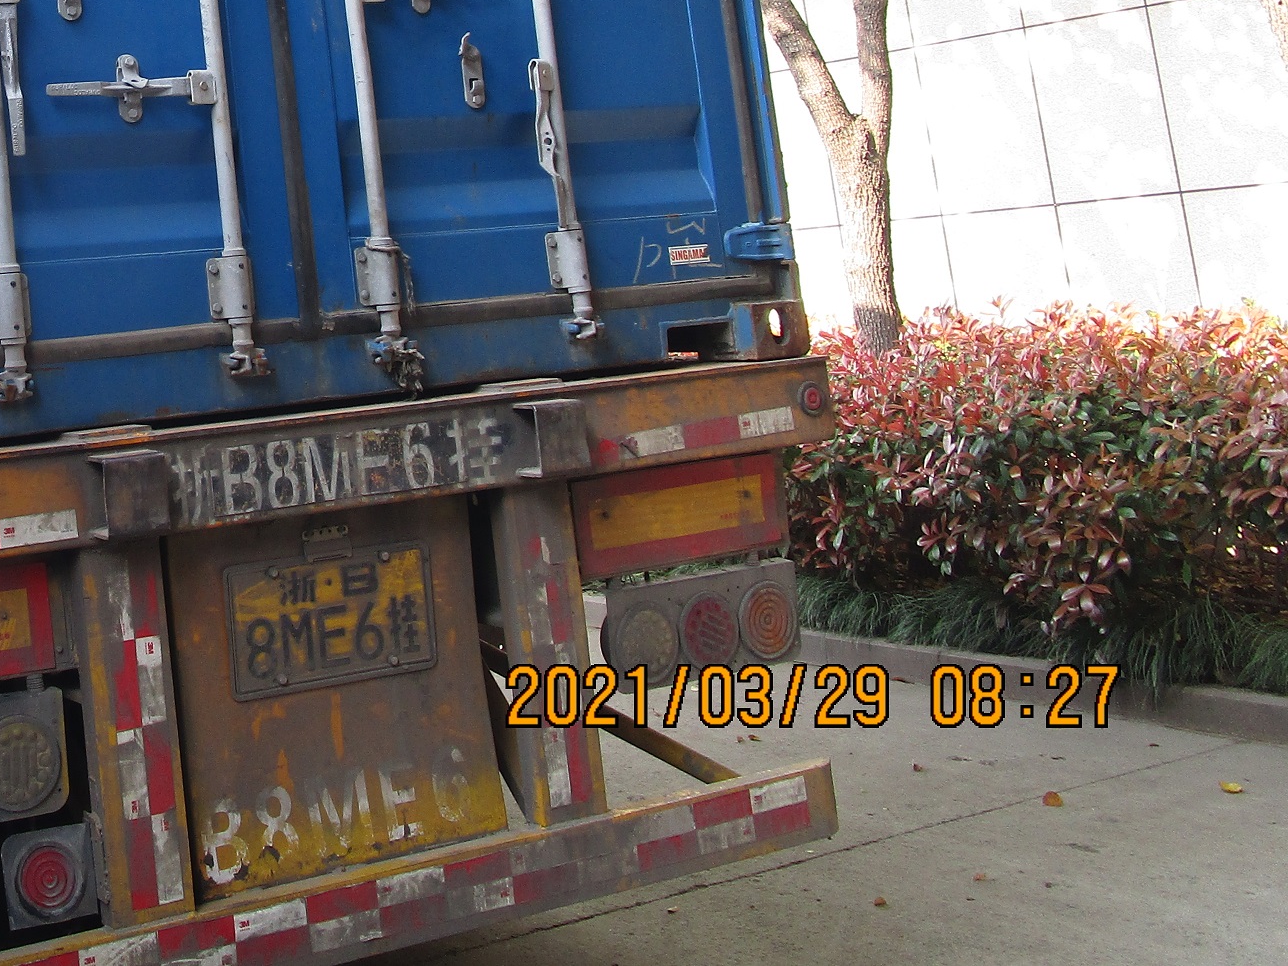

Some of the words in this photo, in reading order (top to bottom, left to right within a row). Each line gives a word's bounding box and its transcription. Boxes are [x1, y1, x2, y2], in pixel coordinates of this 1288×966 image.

[3, 527, 15, 535] 3M
[239, 920, 250, 929] 3M
[84, 956, 96, 965] 3M
